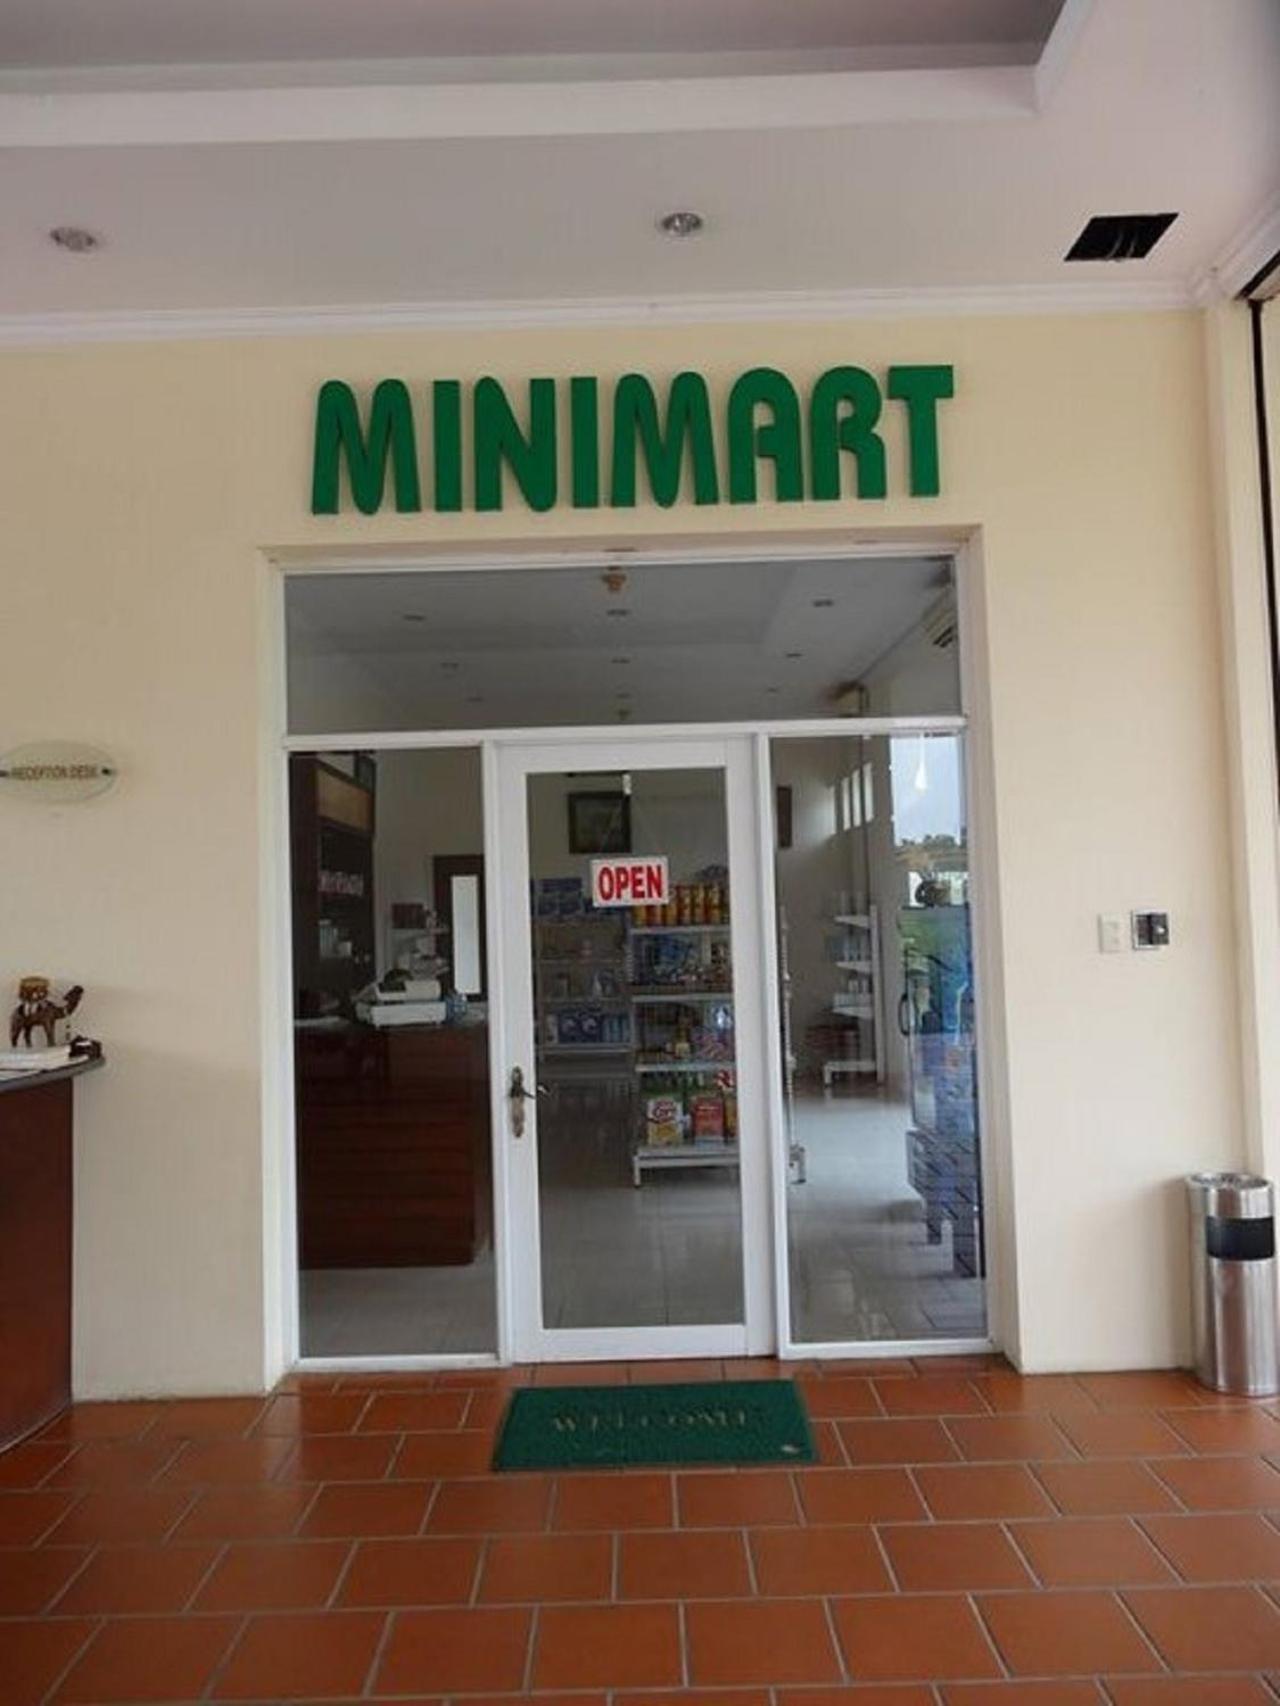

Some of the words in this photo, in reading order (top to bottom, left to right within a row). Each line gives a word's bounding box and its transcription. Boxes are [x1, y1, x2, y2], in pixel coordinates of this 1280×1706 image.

[311, 364, 955, 515] MINIMART
[599, 864, 662, 901] OPEN
[552, 1408, 749, 1432] WELCOME
